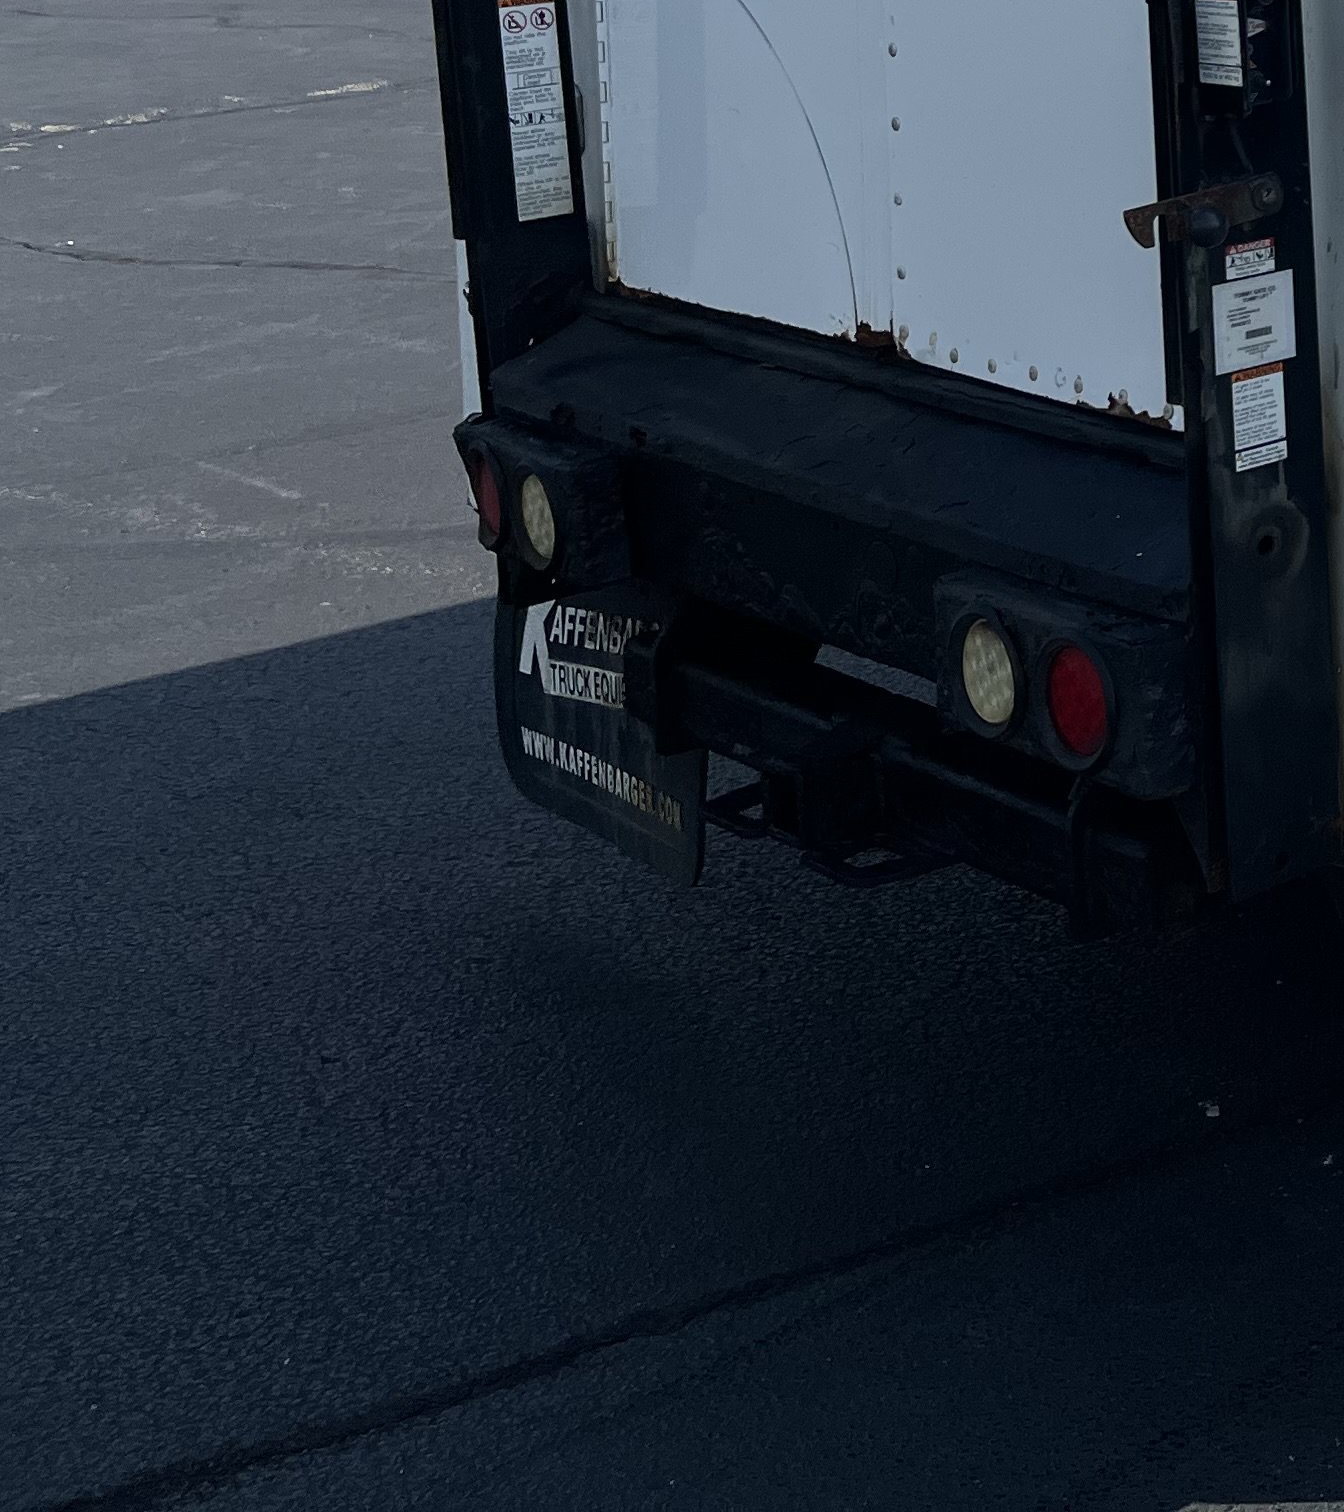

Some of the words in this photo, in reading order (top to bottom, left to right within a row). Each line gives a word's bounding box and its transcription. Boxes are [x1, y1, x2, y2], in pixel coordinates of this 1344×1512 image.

[1237, 238, 1271, 253] DANGER
[549, 662, 593, 698] TRUCK
[521, 725, 683, 832] WWW.KAFFENBARGER.COM
